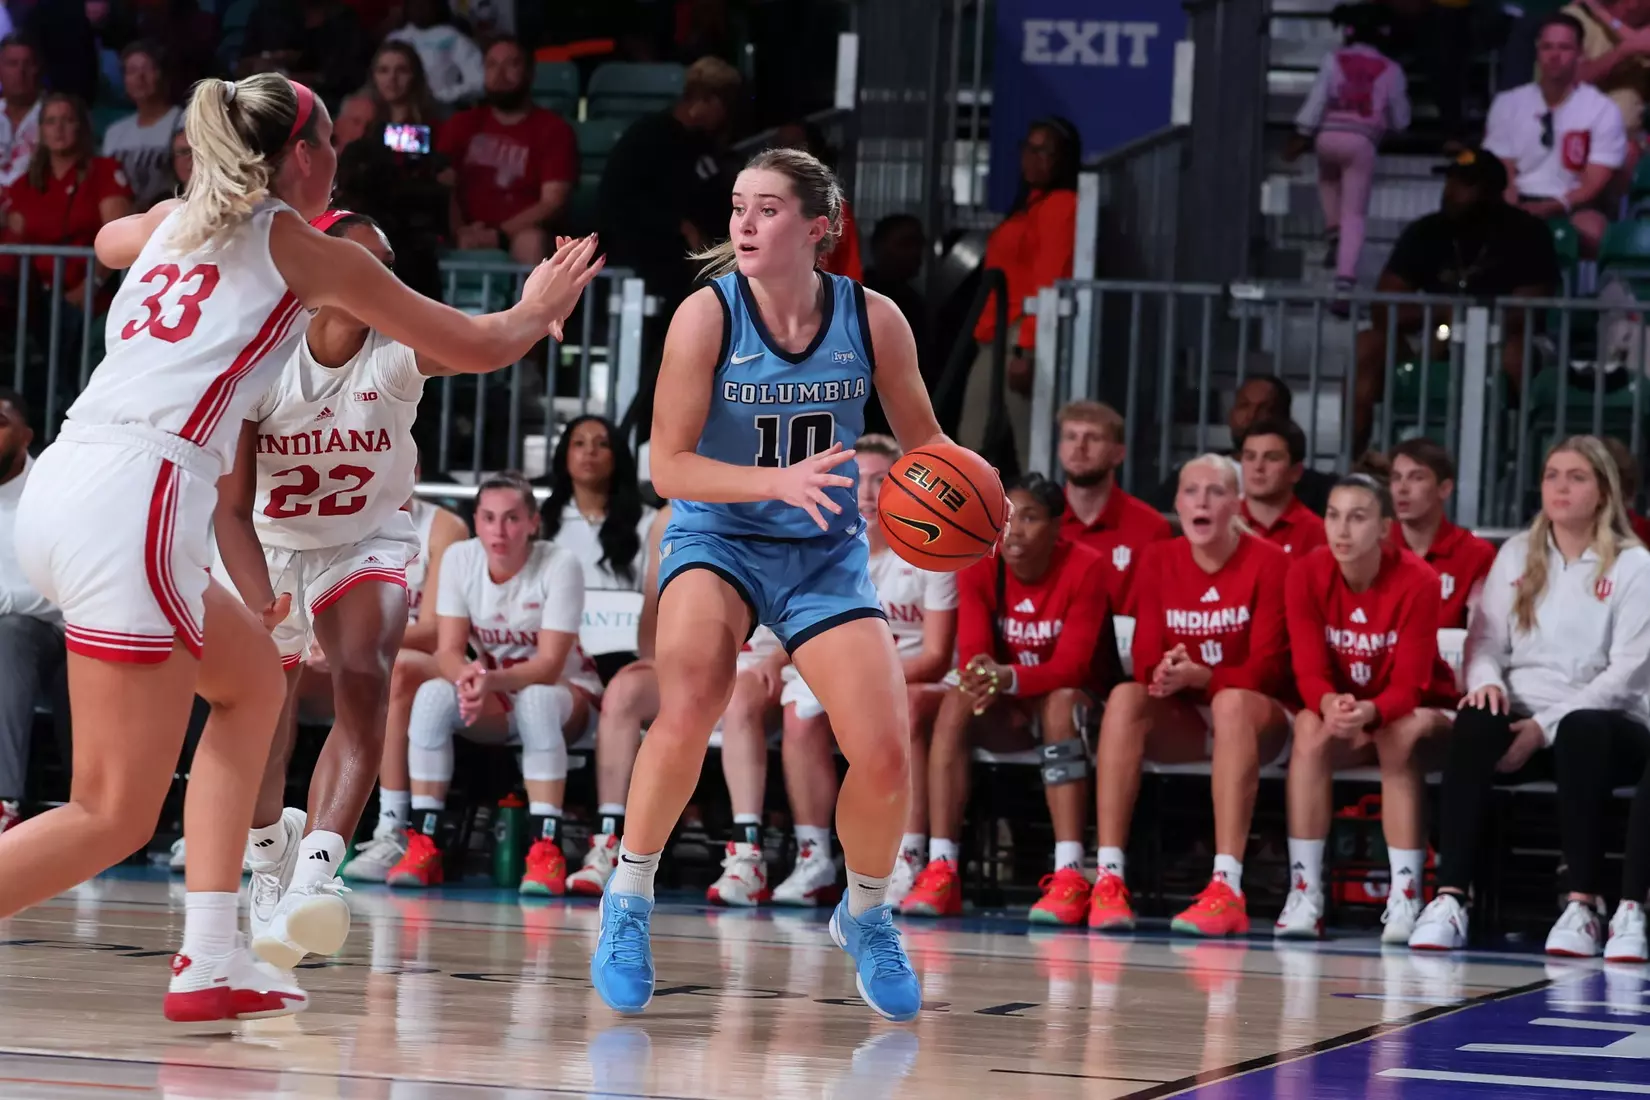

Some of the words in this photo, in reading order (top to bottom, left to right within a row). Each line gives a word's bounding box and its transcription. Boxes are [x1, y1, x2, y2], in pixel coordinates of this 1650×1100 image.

[1022, 20, 1158, 67] EXIT
[121, 264, 220, 343] 33
[723, 377, 866, 404] COLUMBIA
[256, 429, 392, 456] INDIANA
[754, 411, 835, 468] 10
[263, 464, 375, 518] 22
[904, 462, 967, 514] ELITE
[583, 612, 640, 627] ANTI
[1166, 606, 1250, 628] INDIANA
